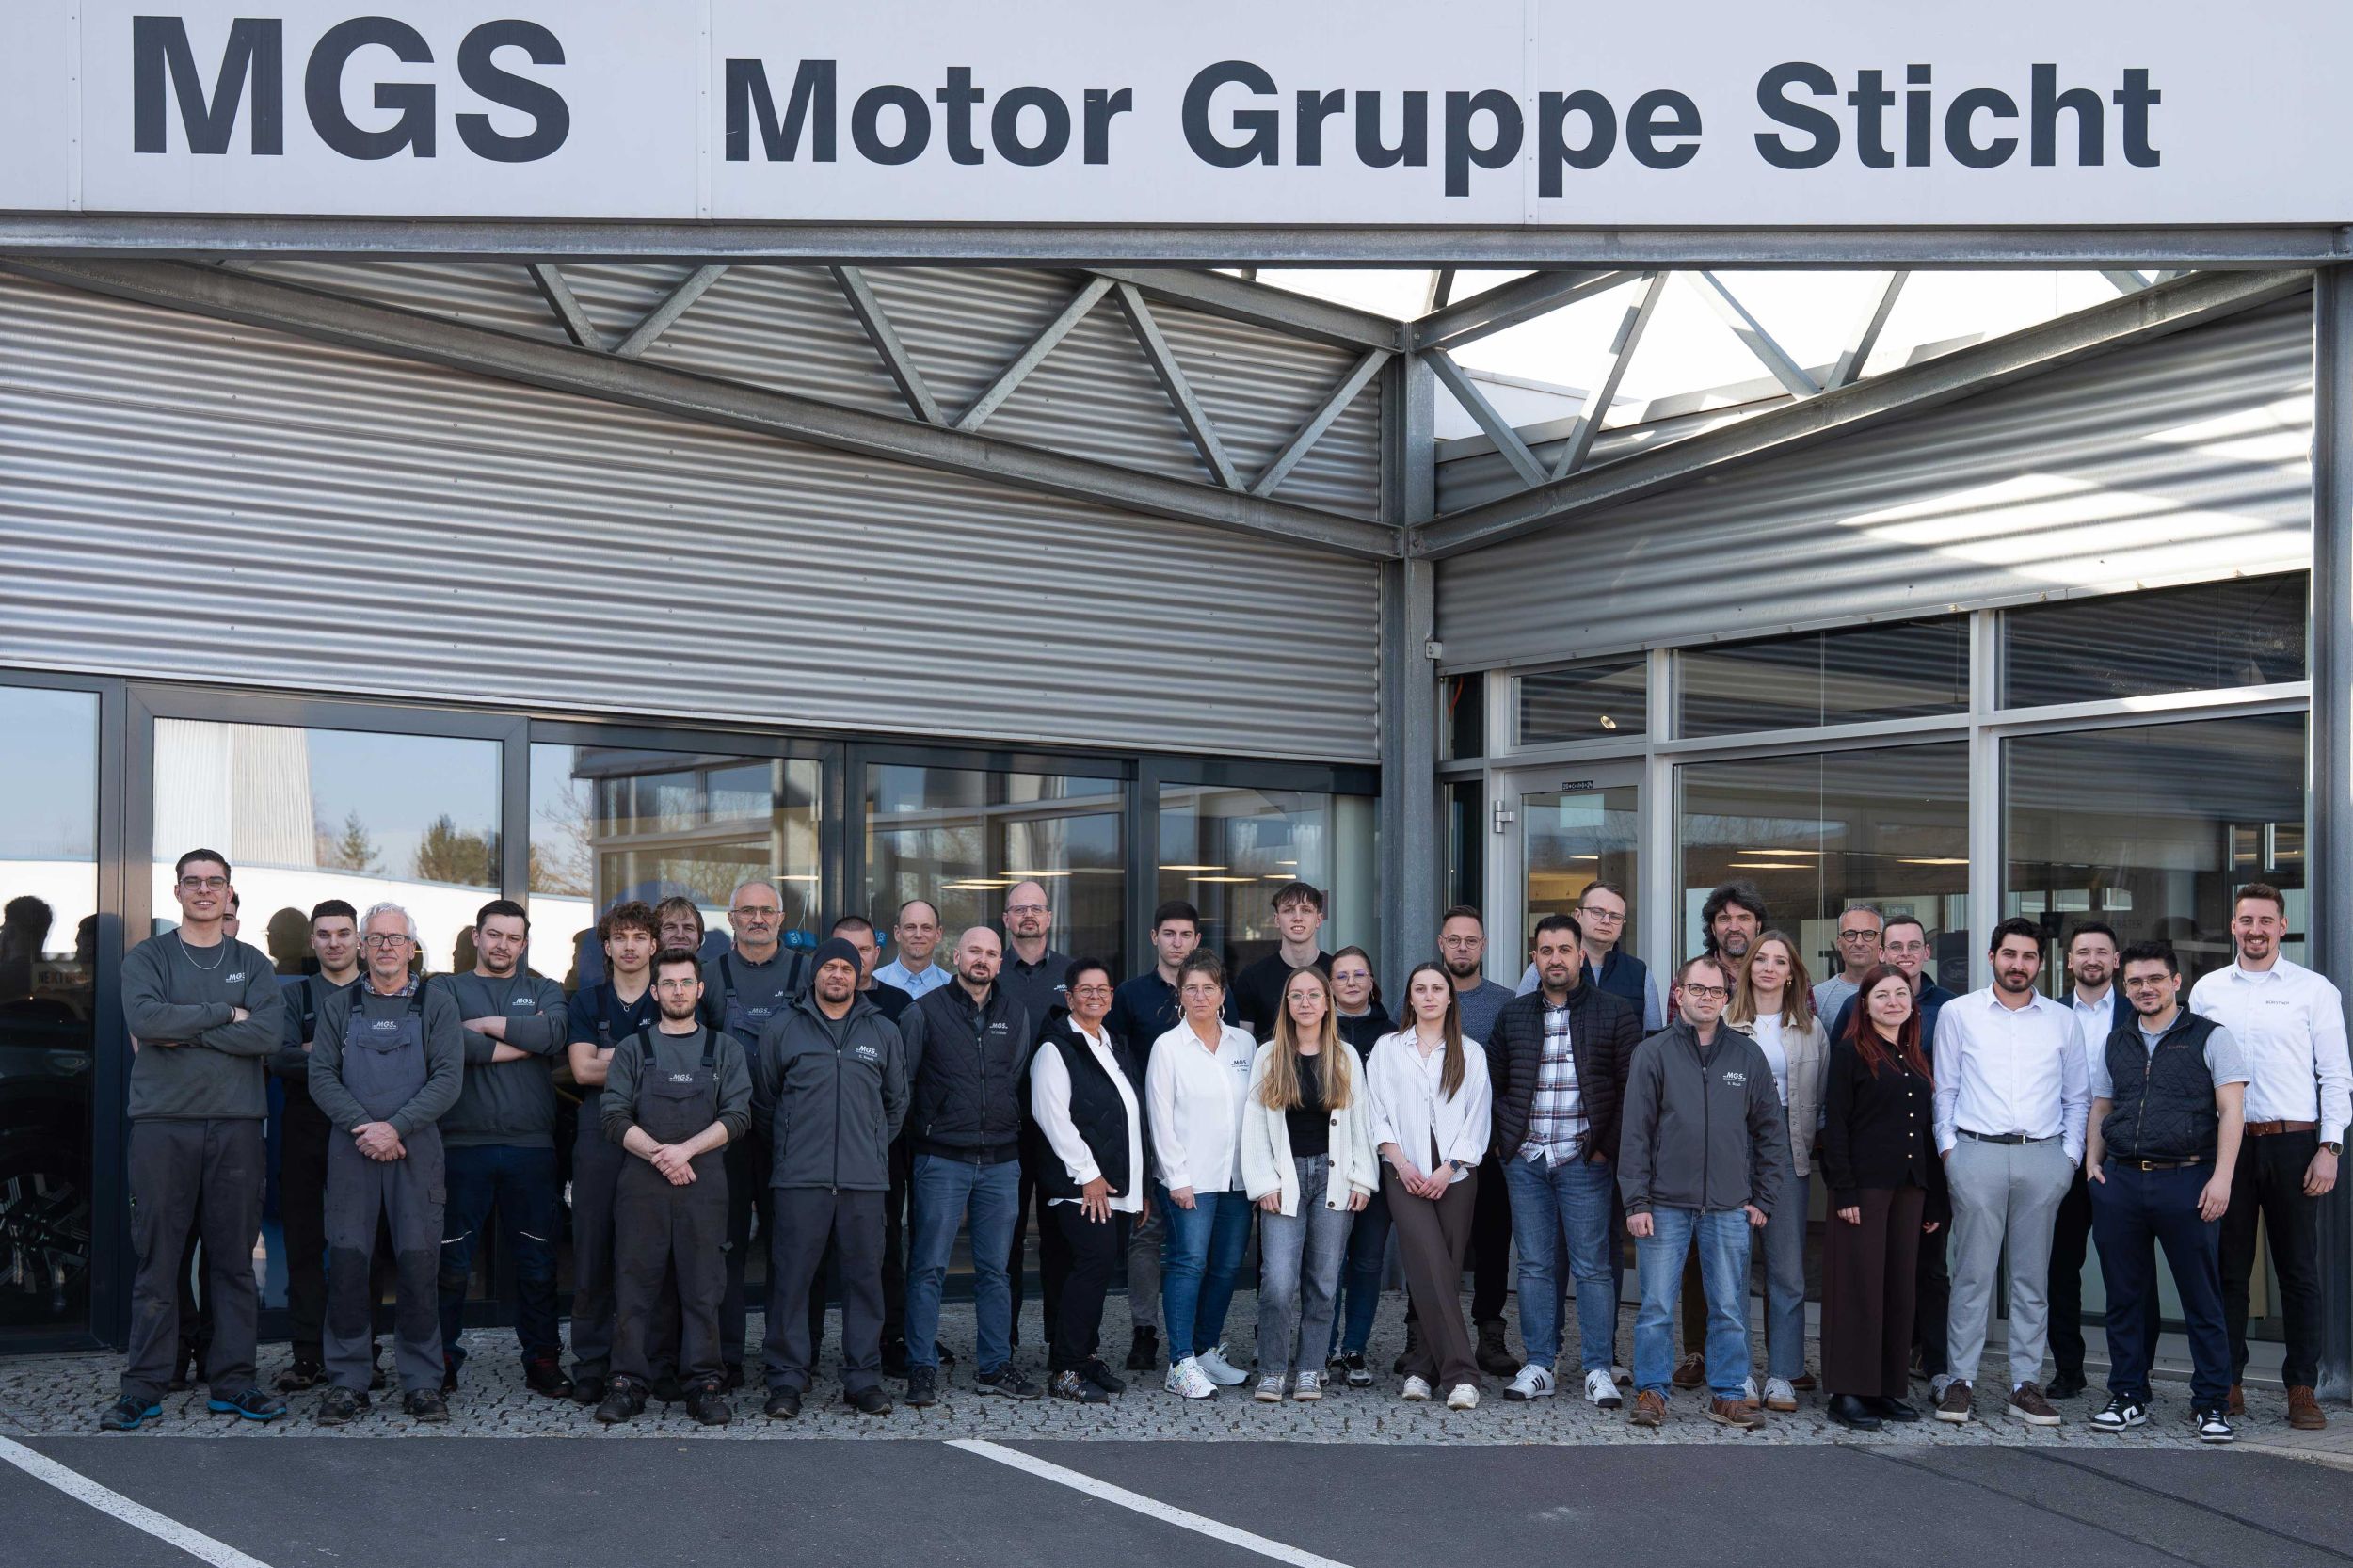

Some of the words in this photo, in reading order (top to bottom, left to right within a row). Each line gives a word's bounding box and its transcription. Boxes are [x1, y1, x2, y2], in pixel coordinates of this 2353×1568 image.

[133, 15, 570, 163] MGS
[725, 58, 1133, 168] Motor
[1181, 60, 1703, 198] Gruppe
[1753, 61, 2161, 170] Sticht
[858, 1045, 876, 1055] MGS
[1726, 1071, 1744, 1080] MGS
